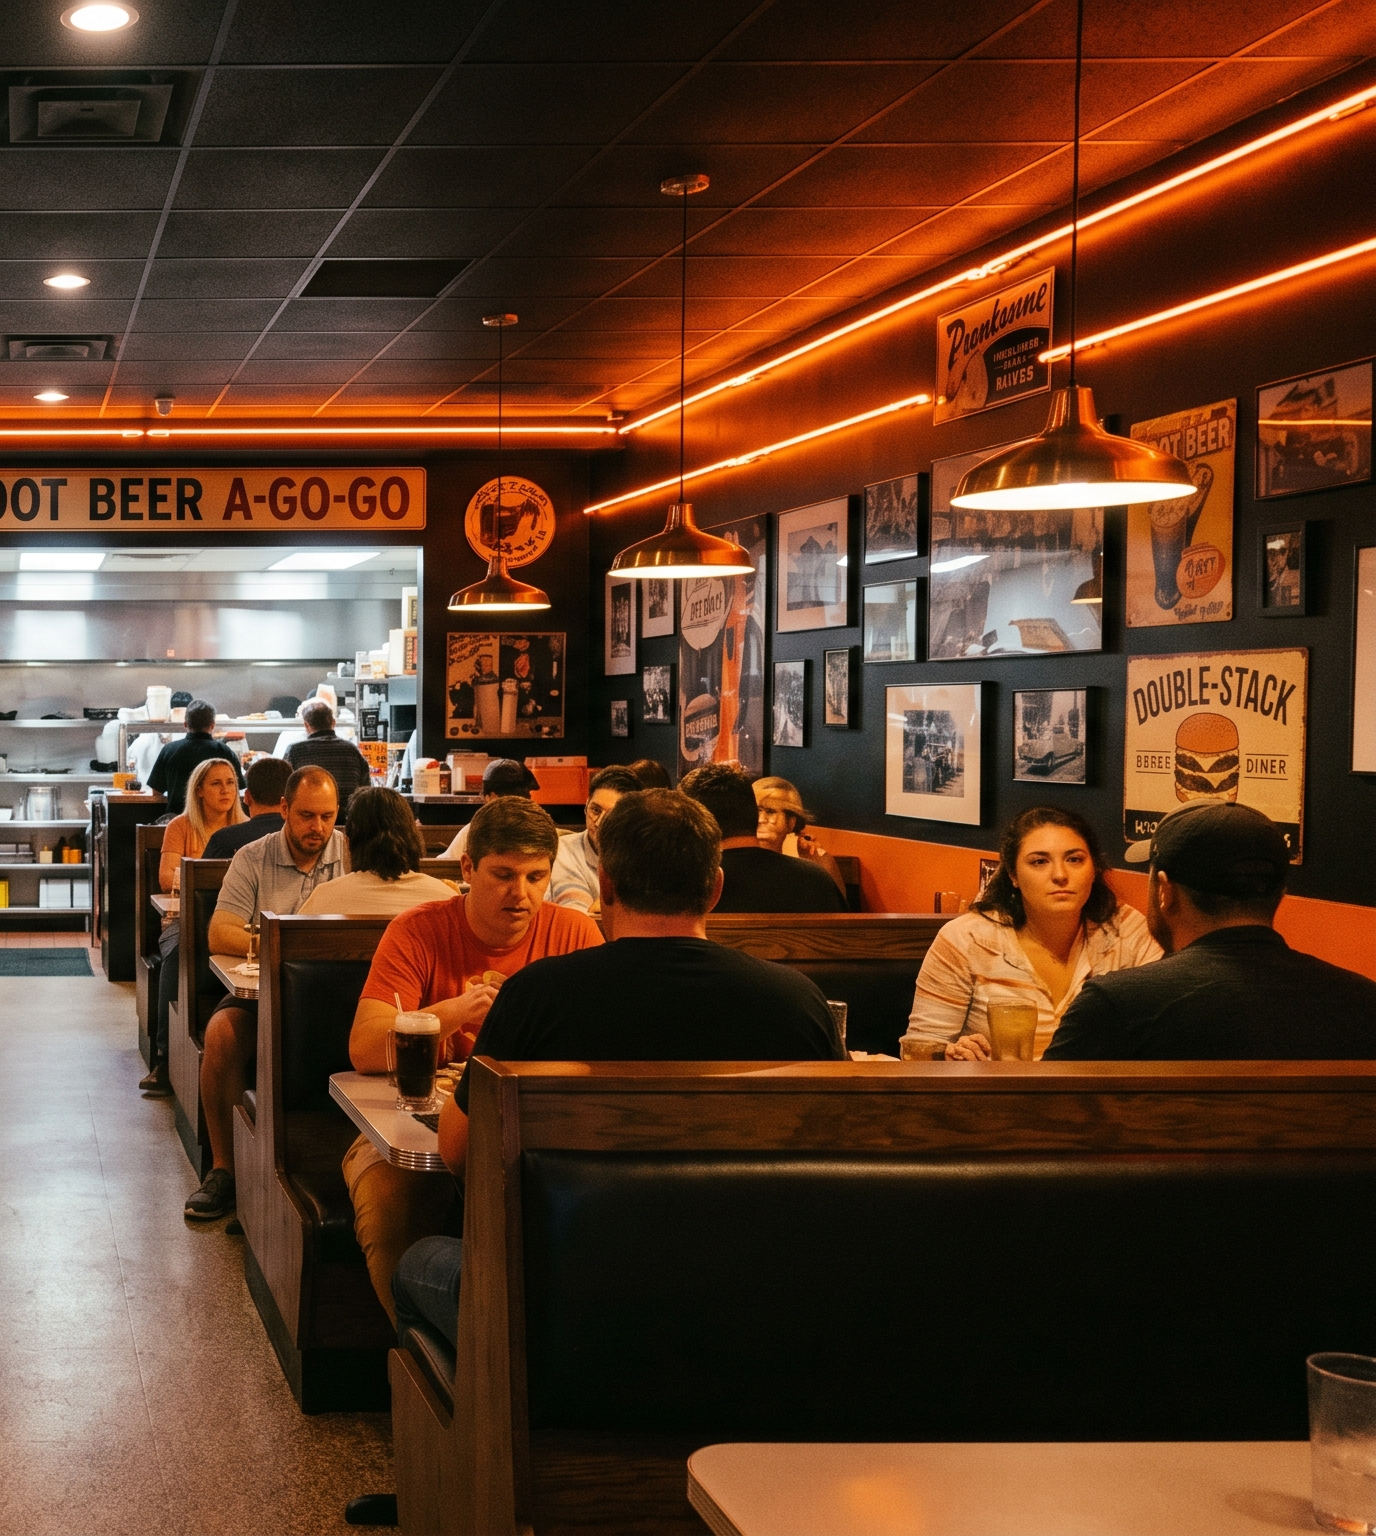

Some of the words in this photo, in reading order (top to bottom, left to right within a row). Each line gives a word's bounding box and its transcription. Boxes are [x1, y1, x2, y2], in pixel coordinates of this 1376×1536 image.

[1185, 417, 1230, 459] BEER
[89, 477, 203, 521] BEER
[222, 475, 410, 522] A-GO-GO
[1132, 665, 1297, 726] DOUBLE-STACK
[1246, 758, 1287, 775] DINER
